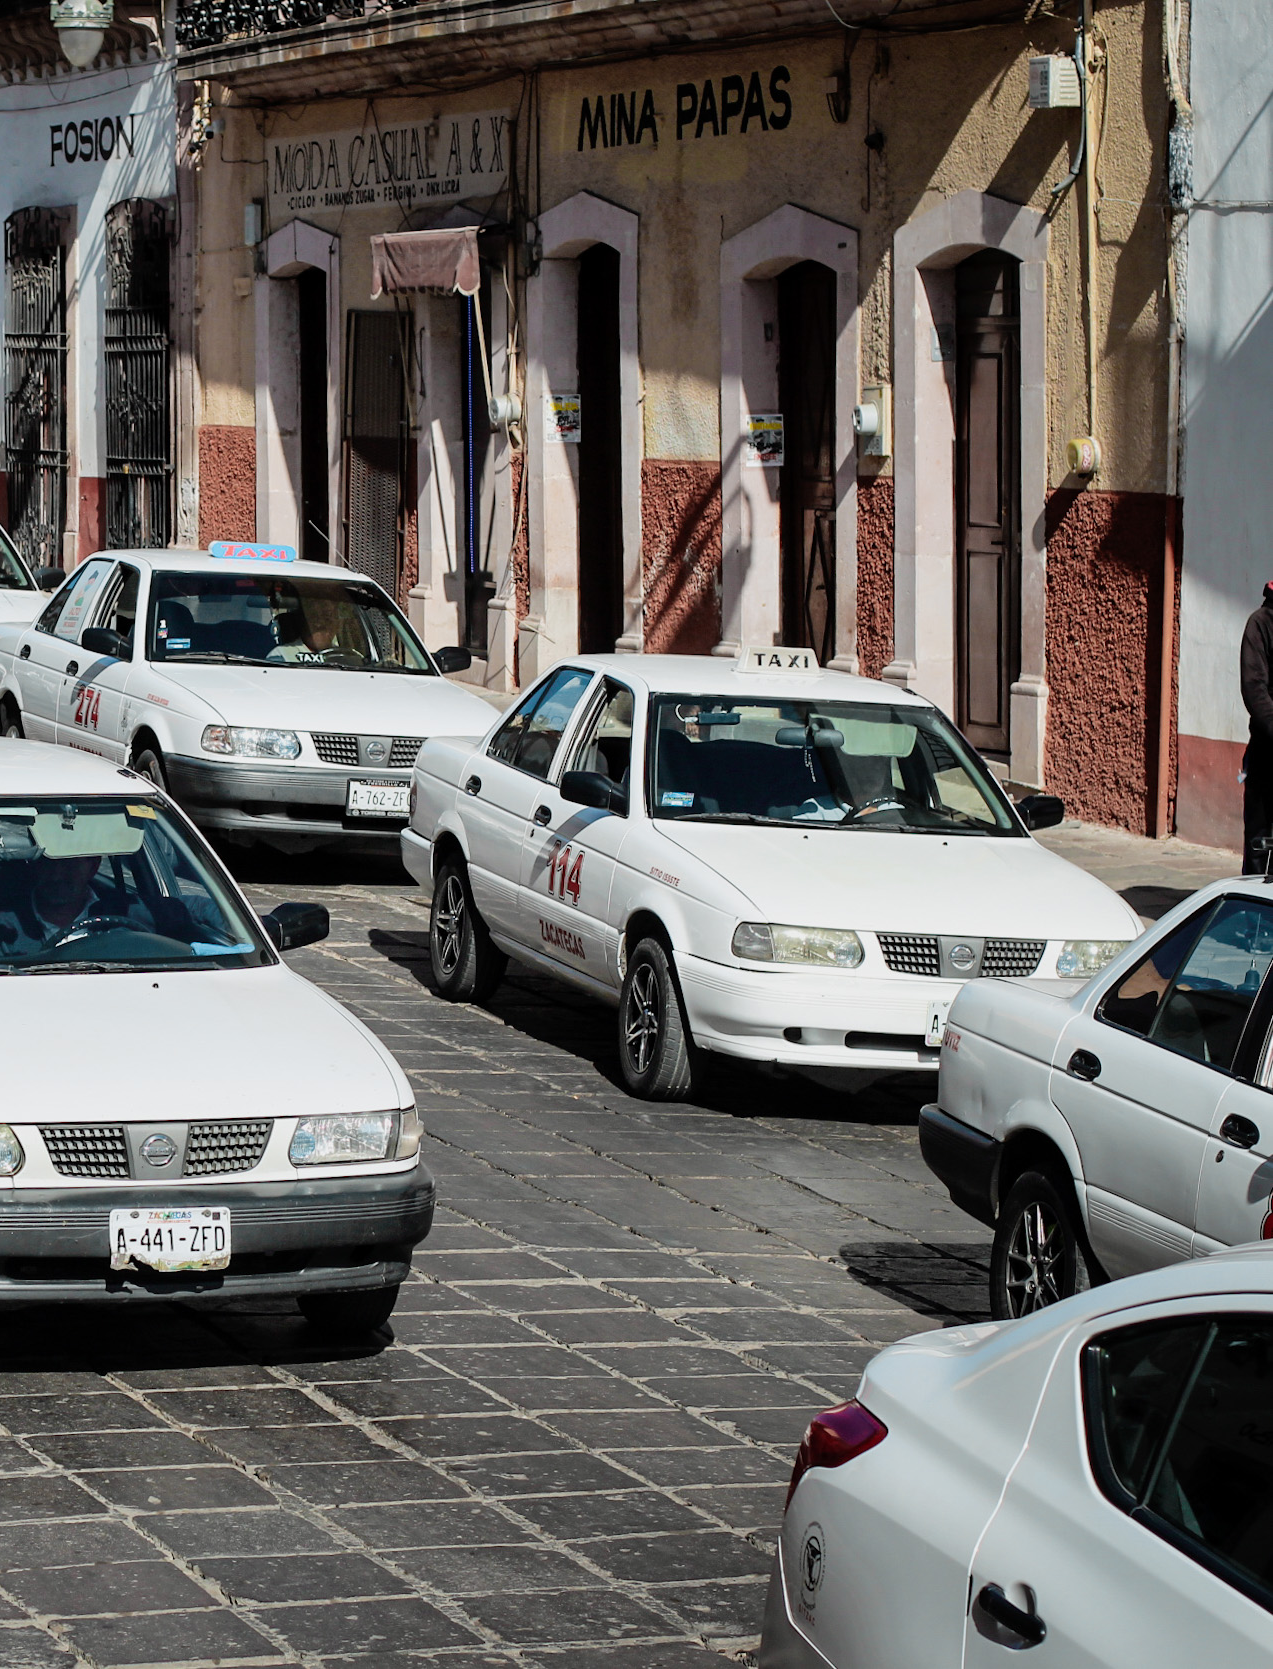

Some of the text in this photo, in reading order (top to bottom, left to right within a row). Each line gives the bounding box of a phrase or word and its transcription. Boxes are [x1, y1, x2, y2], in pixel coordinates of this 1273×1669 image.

[577, 65, 792, 151] MINA PAPAS
[50, 113, 135, 167] FOSION
[274, 115, 505, 194] MODA CASUAL A & X
[221, 544, 287, 560] TAXI
[296, 652, 325, 663] TAXI
[753, 653, 809, 669] TAXI
[74, 684, 102, 731] 274
[546, 840, 585, 906] 114
[649, 866, 663, 879] SITIO
[539, 919, 586, 960] ZACATECAS
[117, 1226, 225, 1252] A-441-ZFD
